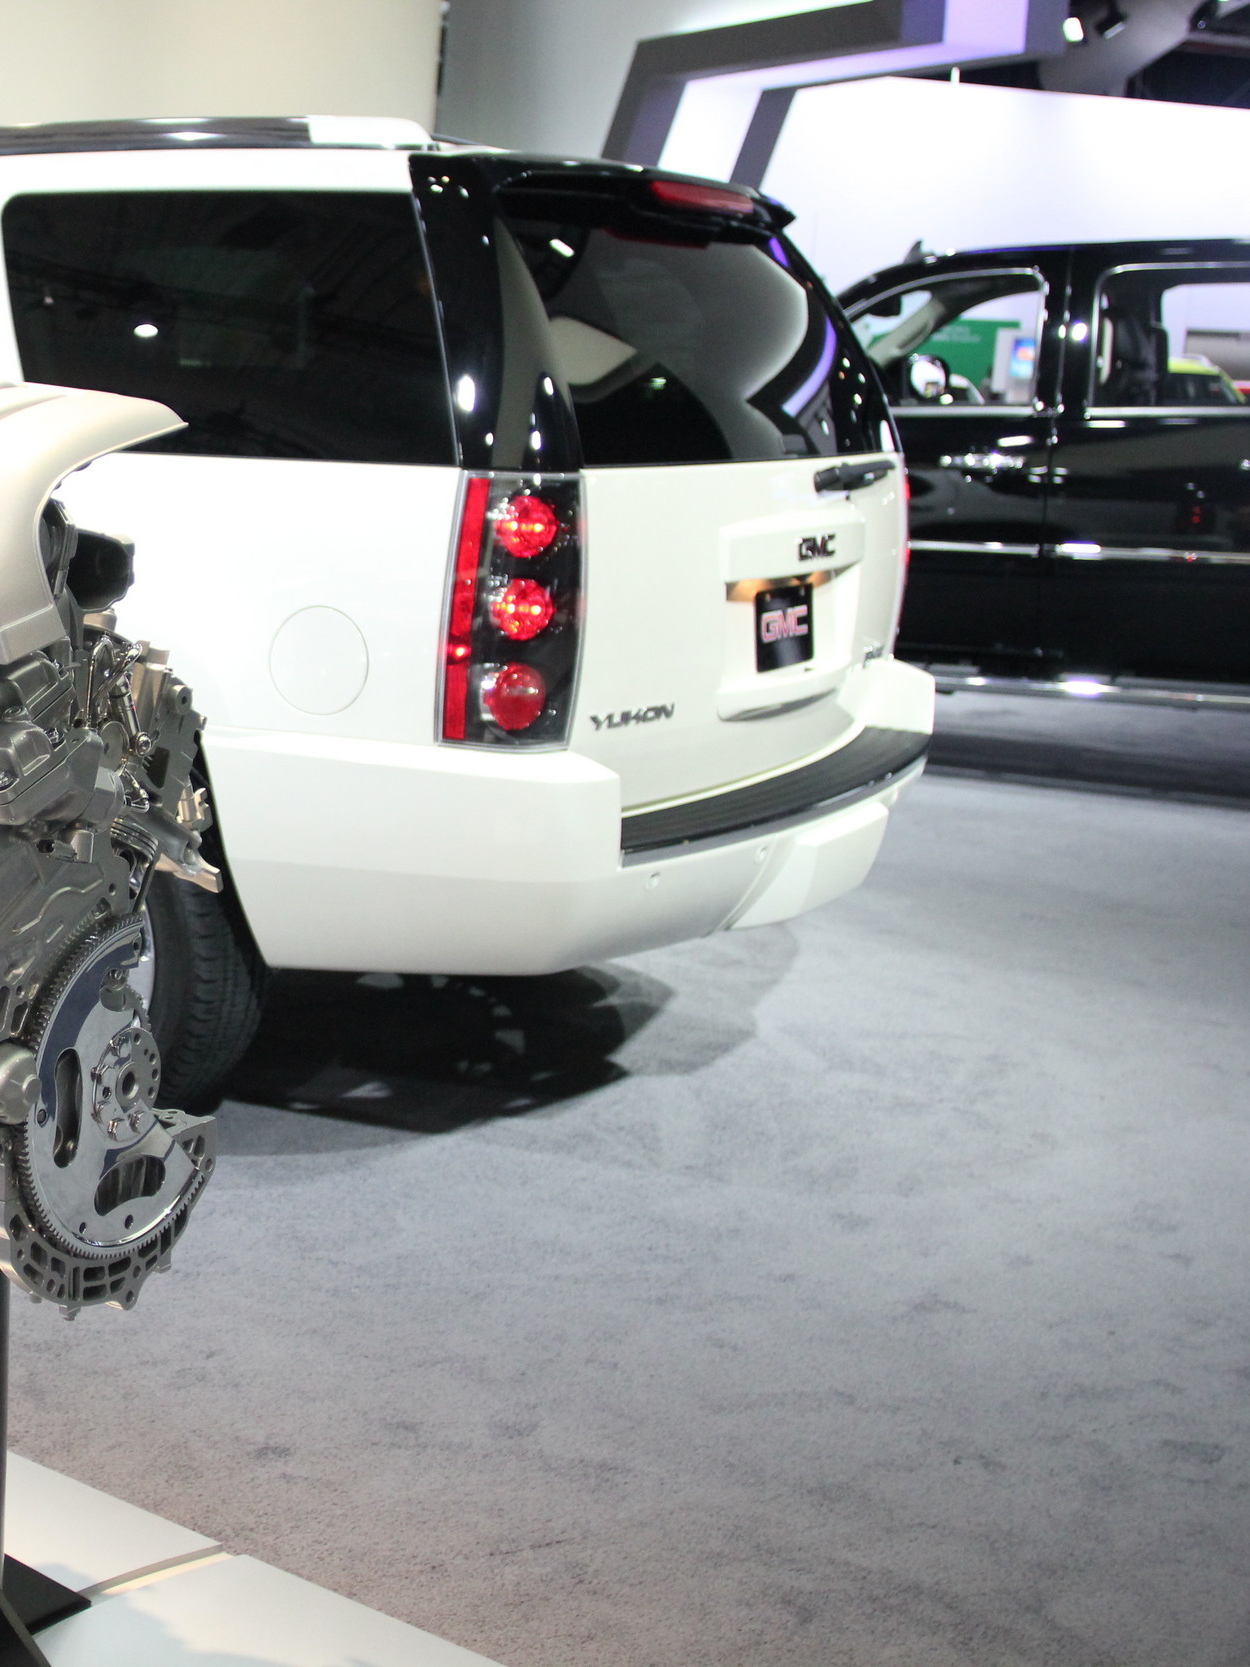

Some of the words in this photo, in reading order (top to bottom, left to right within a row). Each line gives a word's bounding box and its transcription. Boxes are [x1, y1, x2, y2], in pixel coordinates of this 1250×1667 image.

[799, 533, 836, 560] GMC
[761, 604, 809, 644] GMC
[590, 702, 675, 731] YUKON
